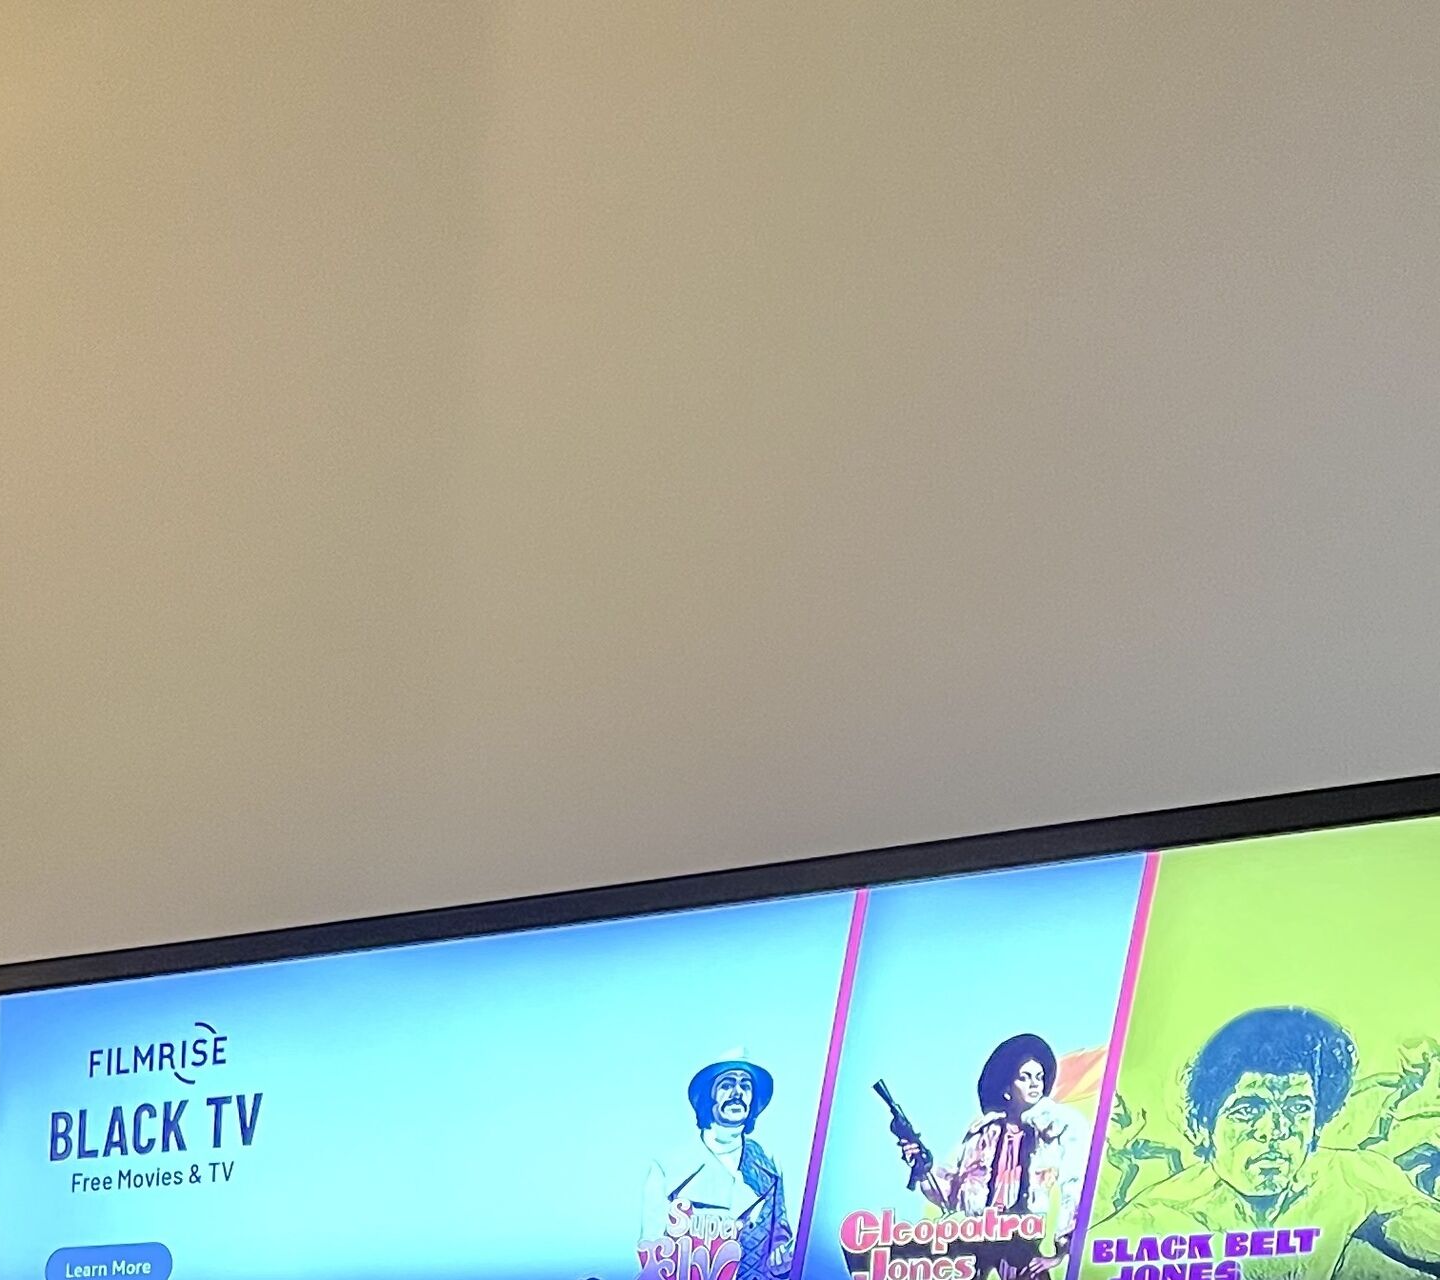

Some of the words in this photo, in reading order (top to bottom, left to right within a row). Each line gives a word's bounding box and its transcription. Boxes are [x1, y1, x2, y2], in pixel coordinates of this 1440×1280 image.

[88, 1034, 228, 1080] FILMRISE
[49, 1099, 190, 1162] BLACK
[206, 1092, 264, 1149] TV
[72, 1172, 113, 1193] Free
[117, 1167, 184, 1190] Movies
[188, 1163, 202, 1184] &
[208, 1160, 235, 1183] TV
[840, 1207, 1046, 1255] Cleopatra
[1091, 1233, 1213, 1265] BLACK
[1223, 1227, 1321, 1259] BELT
[65, 1263, 107, 1279] Learn
[111, 1260, 152, 1276] More
